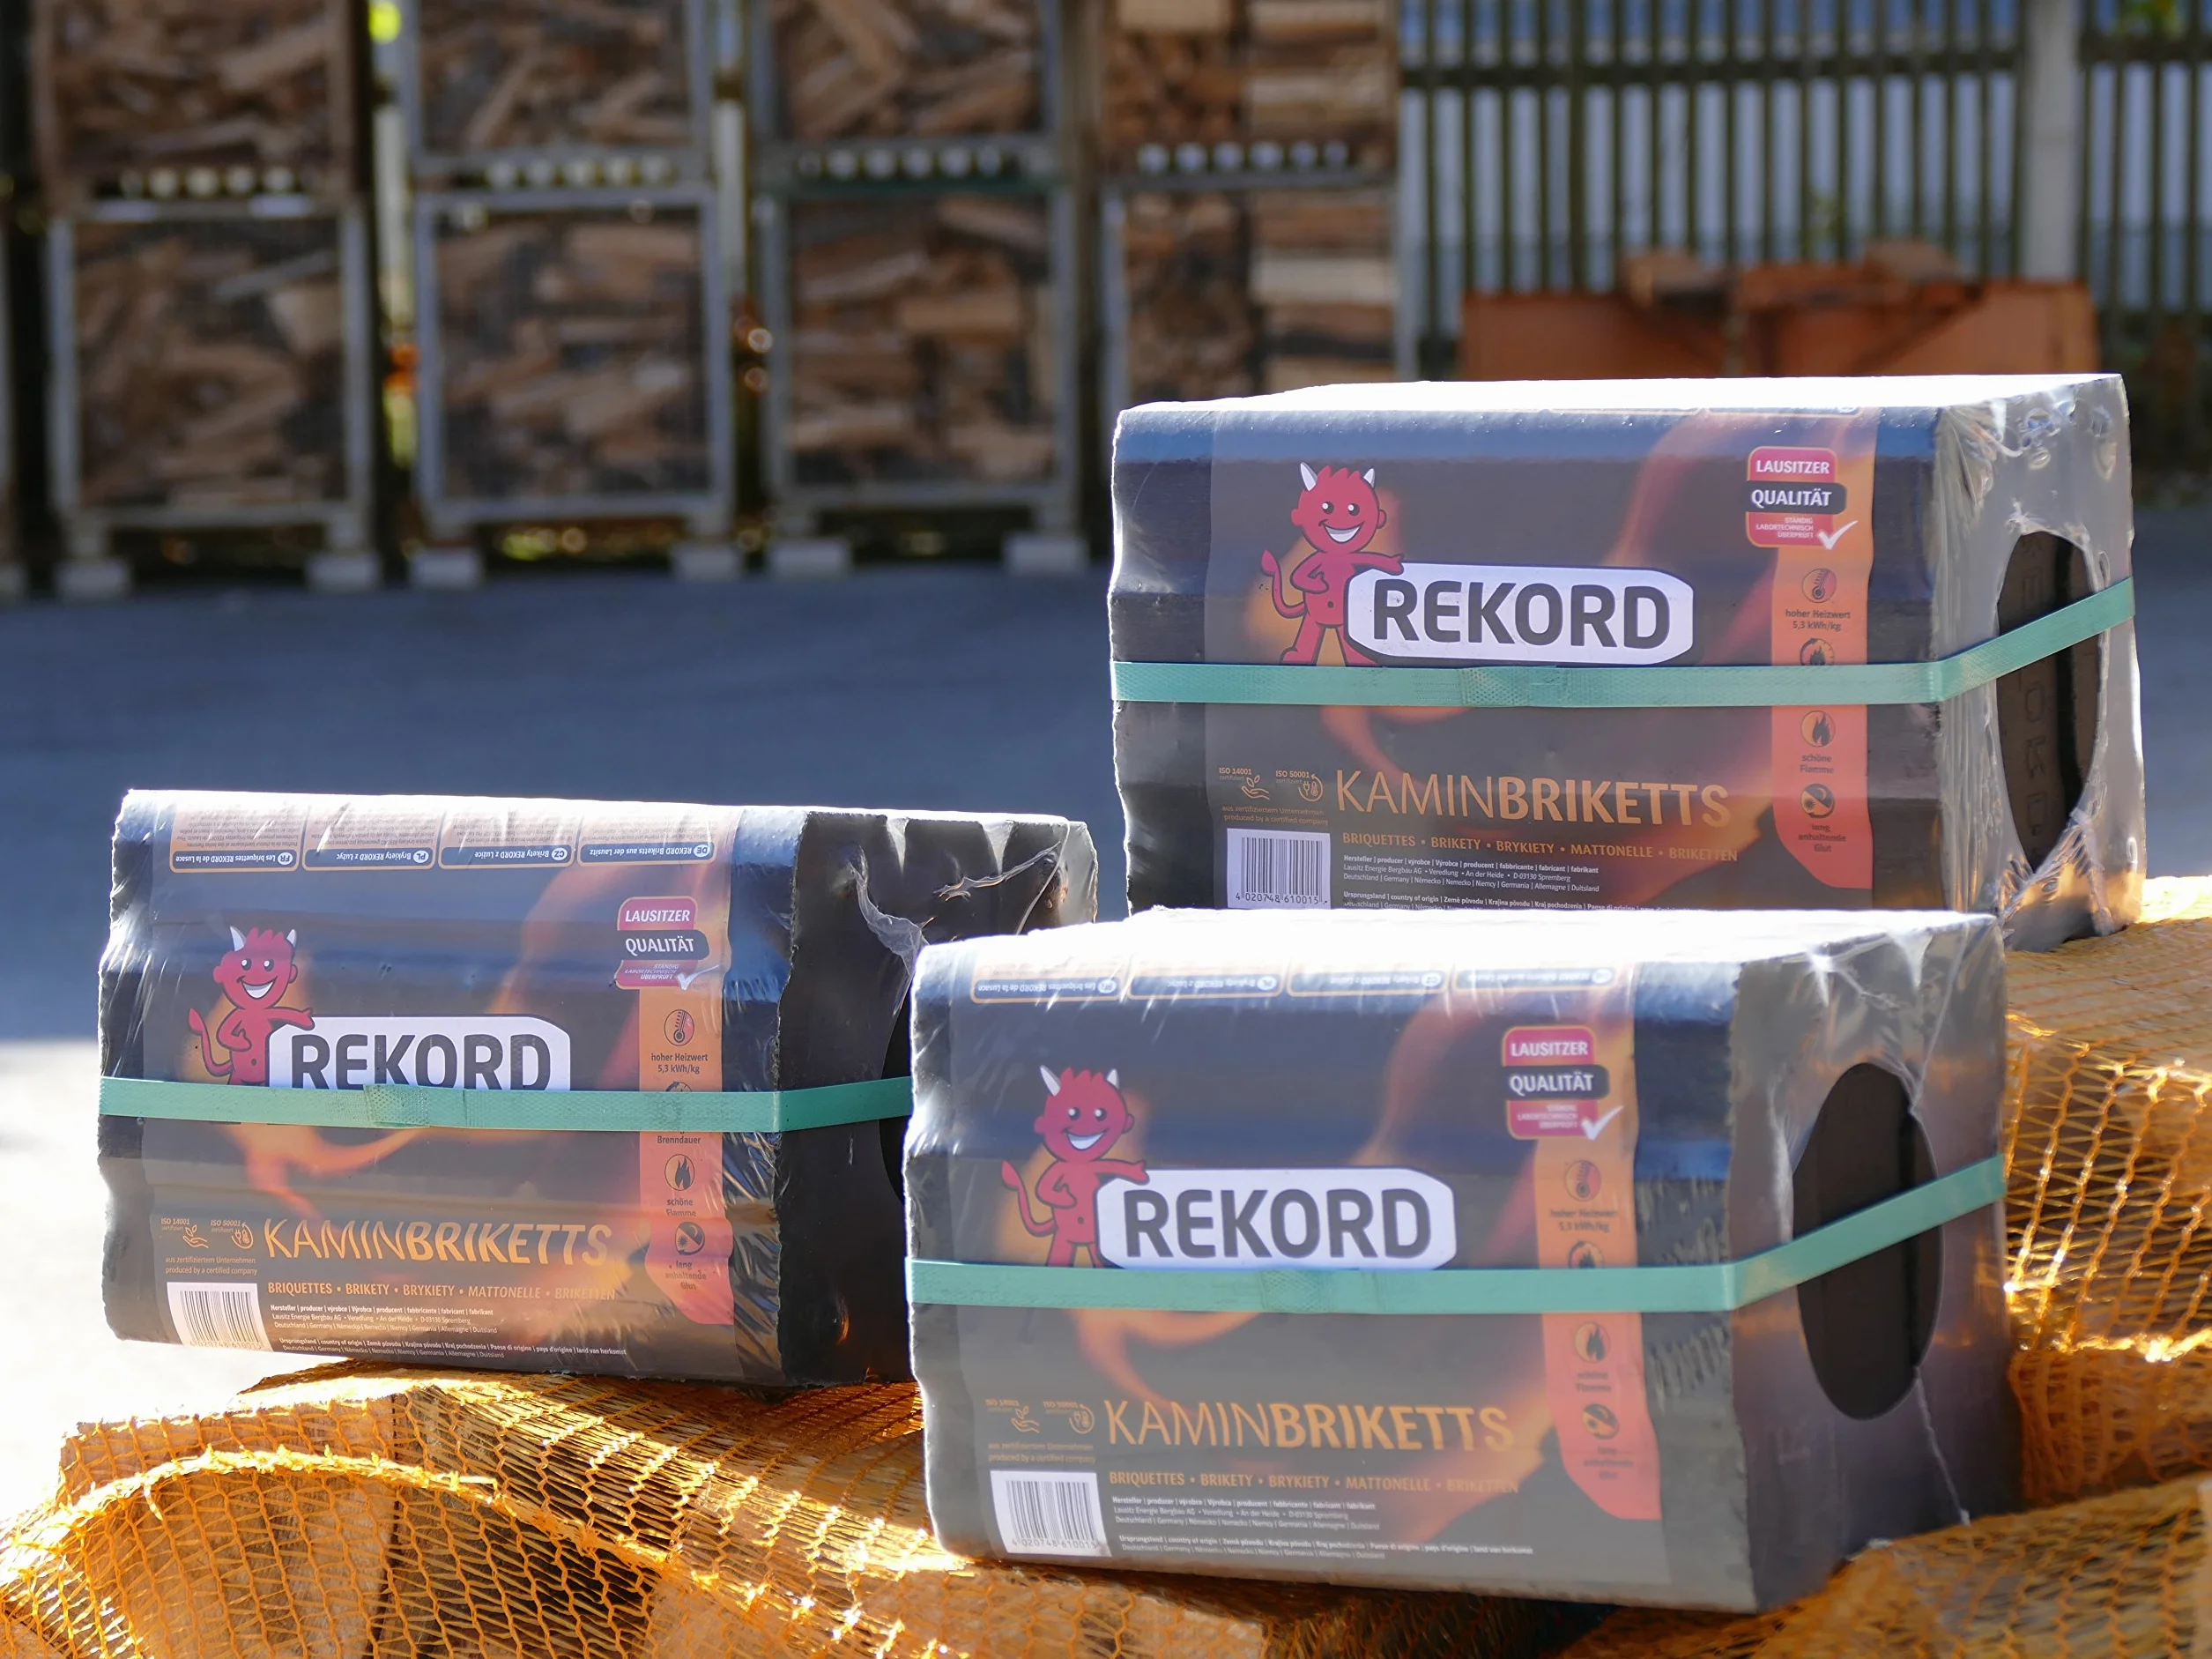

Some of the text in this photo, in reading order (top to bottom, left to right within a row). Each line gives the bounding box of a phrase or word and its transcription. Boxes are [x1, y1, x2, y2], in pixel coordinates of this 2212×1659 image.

[1755, 460, 1830, 474] LAUSITZER
[1751, 488, 1832, 509] QUALITÄT
[1374, 579, 1670, 649] REKORD
[1785, 608, 1851, 619] hoher Heizwert
[1793, 621, 1842, 632] 5,3 kWh/kg
[1801, 754, 1831, 763] schöne
[1336, 770, 1732, 828] KAMINBRIKETTS
[1224, 814, 1254, 822] produced
[1256, 815, 1264, 823] by
[1342, 832, 1737, 861] BRIQUETTES BRIKETY BRYKIETY MATTONELLE BRIKETTEN
[235, 853, 264, 862] briquettes
[385, 852, 412, 860] Brykiety
[527, 849, 549, 858] Brikety
[1429, 868, 1459, 877] Veredlung
[1343, 873, 1378, 882] Deutschland
[1534, 882, 1567, 892] Allemagne
[1571, 884, 1600, 893] Duitsland
[1245, 893, 1280, 904] 020748
[1284, 895, 1319, 904] 610015
[1343, 891, 1386, 900] Ursprungsland
[1488, 898, 1508, 907] Krajina
[1534, 901, 1547, 910] Kraj
[625, 910, 691, 922] LAUSITZER
[625, 935, 694, 956] QUALITÄT
[1511, 1041, 1588, 1057] LAUSITZER
[291, 1033, 553, 1090] REKORD
[651, 1053, 709, 1061] hoher Heizwert
[657, 1064, 701, 1075] 5,3 kWh/kg
[1509, 1071, 1593, 1097] QUALITÄT
[657, 1135, 701, 1144] Brenndauer
[667, 1198, 694, 1207] schöne
[666, 1209, 696, 1217] Flamme
[1123, 1188, 1432, 1260] REKORD
[264, 1217, 609, 1265] KAMINBRIKETTS
[166, 1267, 192, 1276] produced
[193, 1267, 200, 1276] by
[268, 1282, 615, 1301] BRIQUETTES BRIKETY BRYKIETY MATTONELLE BRIKETTEN
[1102, 1400, 1514, 1452] KAMINBRIKETTS
[1110, 1471, 1519, 1494] BRIQUETTES BRIKETY BRYKIETY MATTONELLE BRIKETTEN
